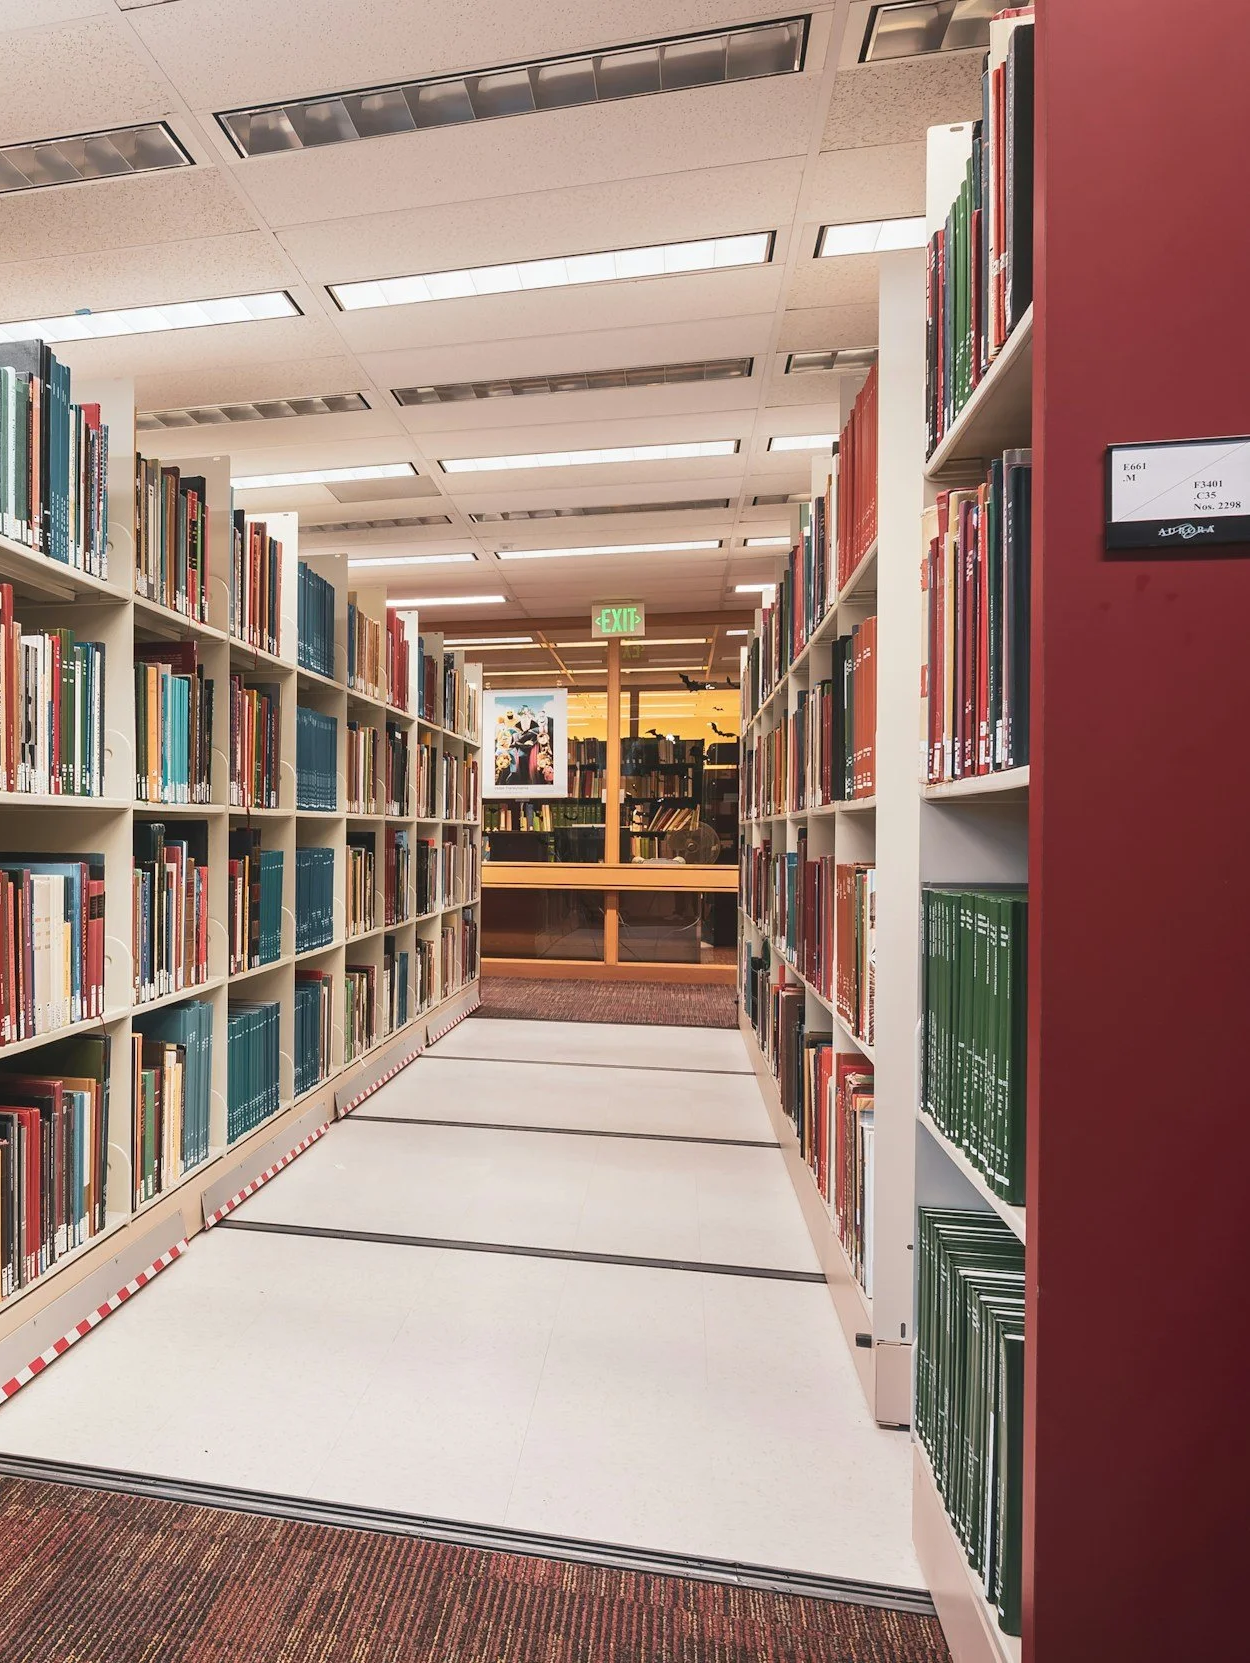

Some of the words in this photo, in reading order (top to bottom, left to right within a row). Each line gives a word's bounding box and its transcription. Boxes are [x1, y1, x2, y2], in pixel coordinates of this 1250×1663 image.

[1123, 462, 1147, 471] E661
[1123, 474, 1136, 483] .M
[1193, 480, 1223, 489] F3401
[1193, 491, 1217, 500] .C35
[1193, 502, 1215, 511] Nos.
[1218, 501, 1241, 510] 2298
[601, 607, 637, 633] EXIT
